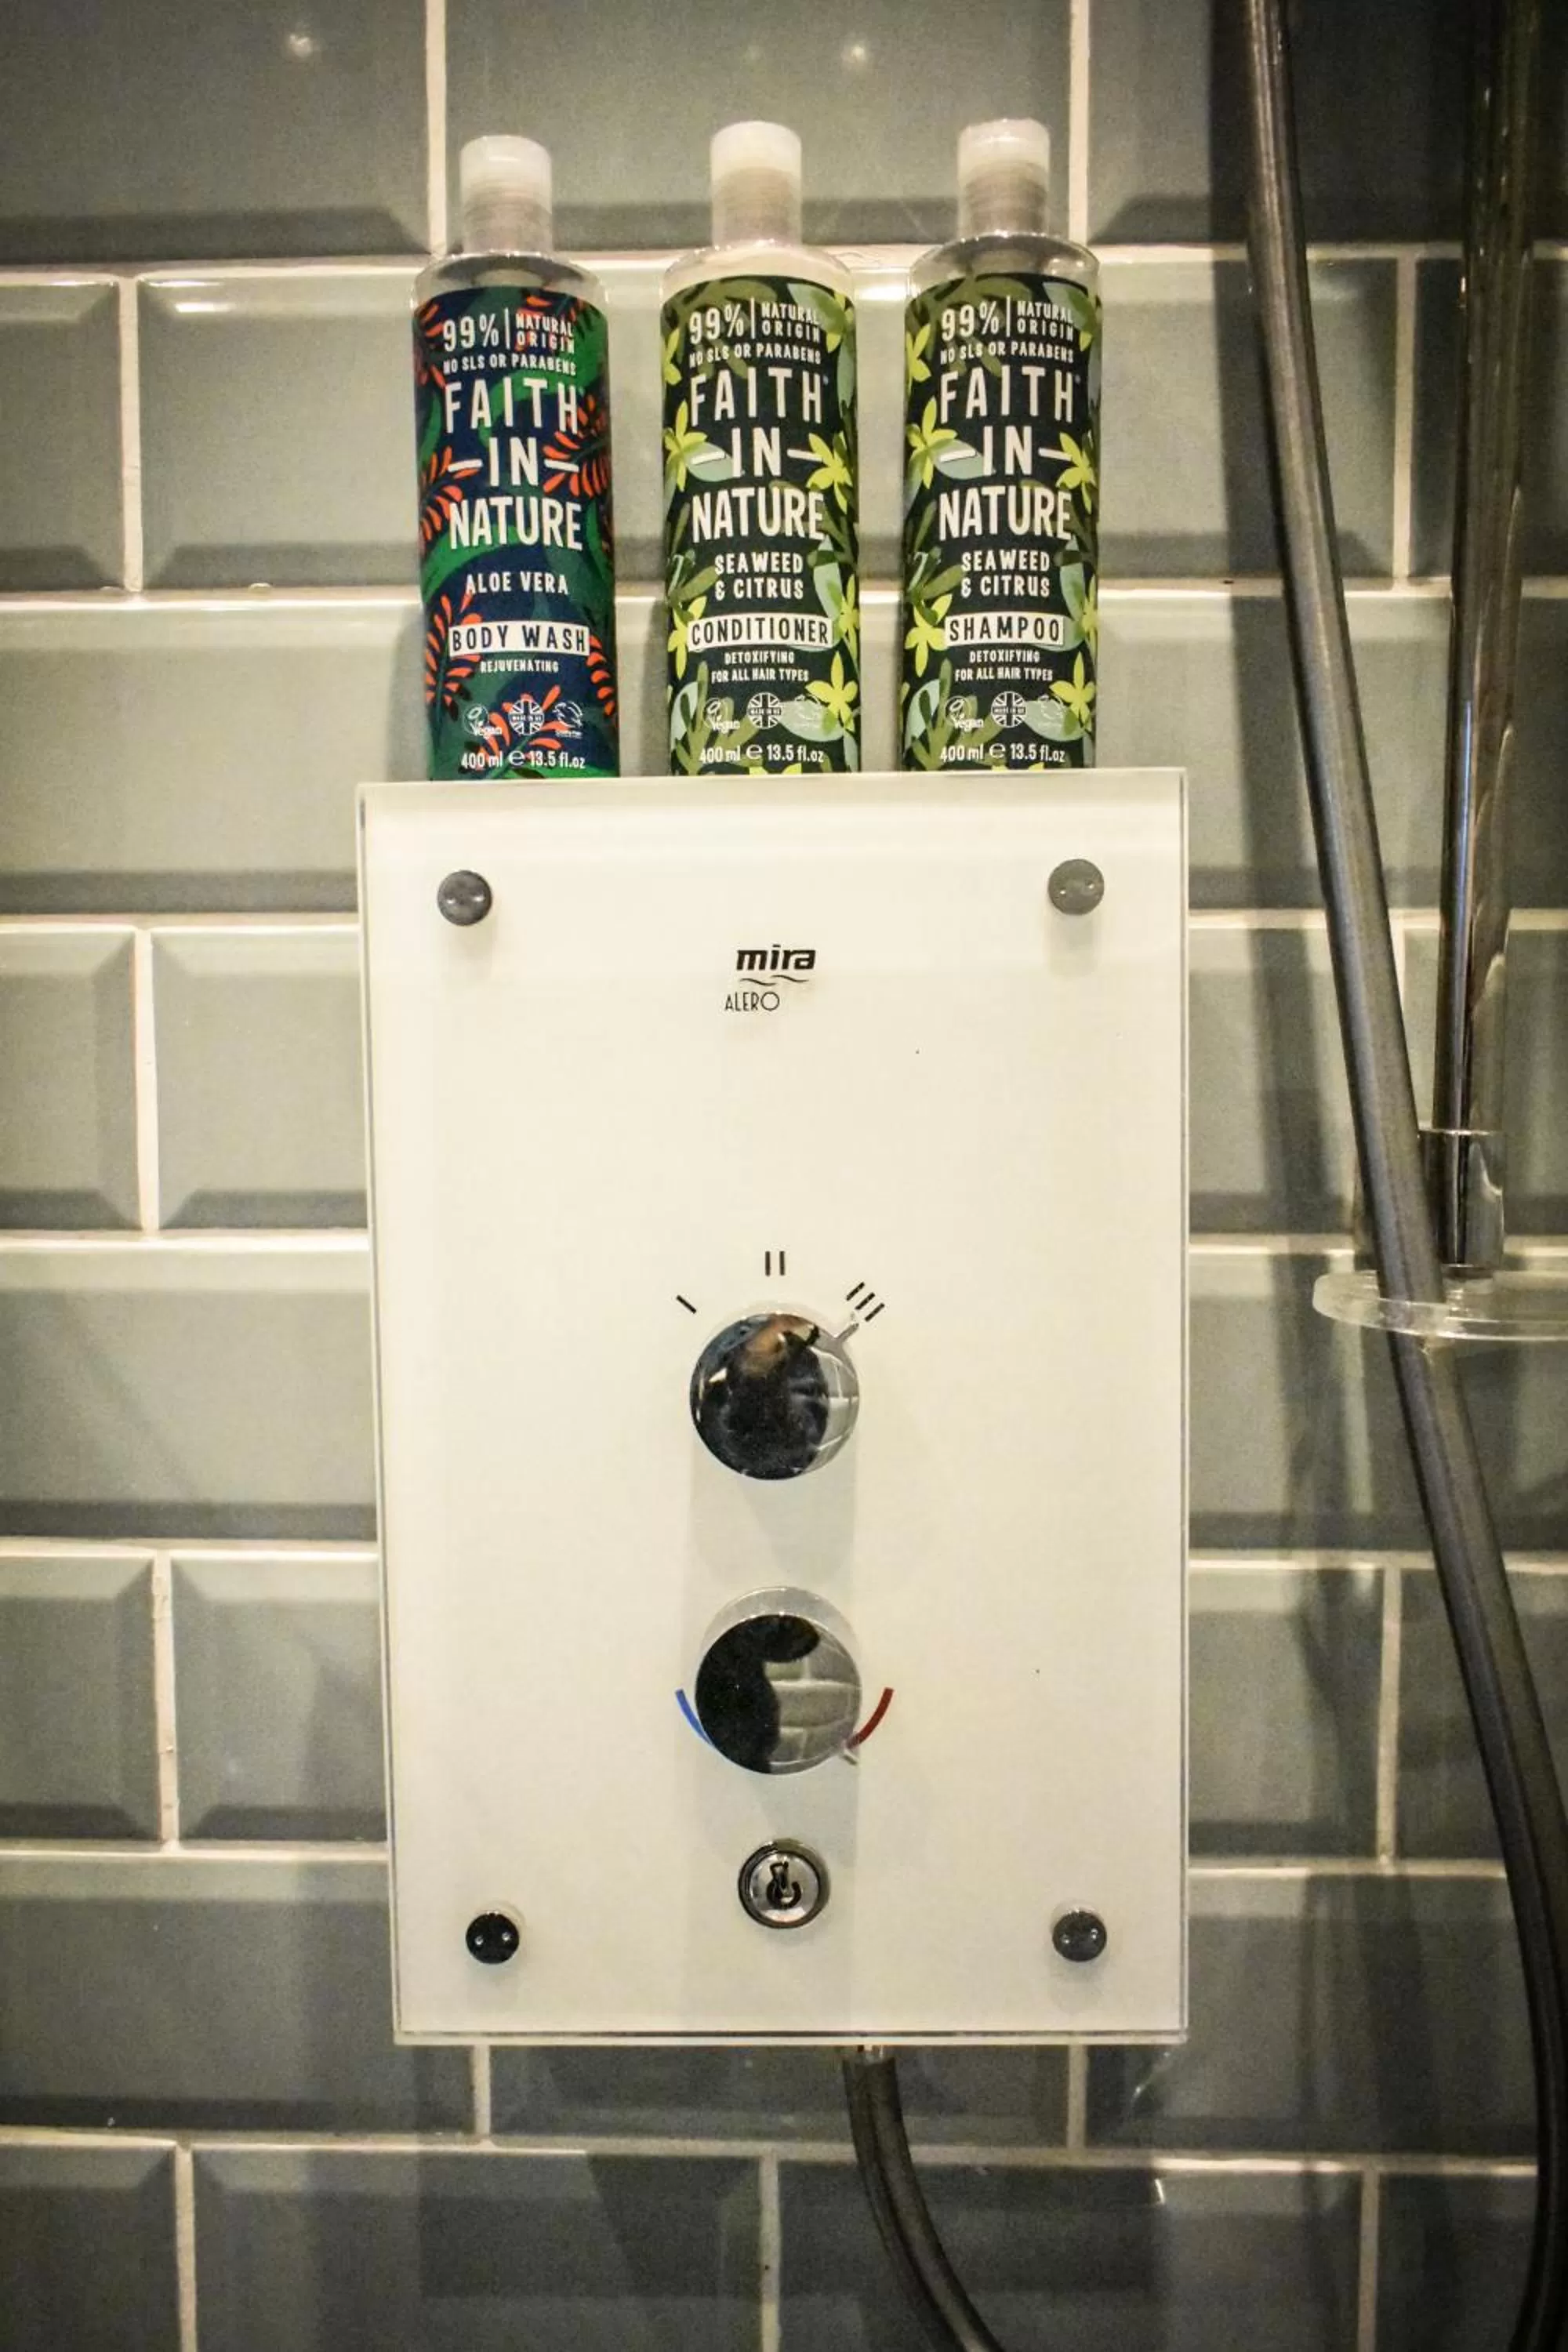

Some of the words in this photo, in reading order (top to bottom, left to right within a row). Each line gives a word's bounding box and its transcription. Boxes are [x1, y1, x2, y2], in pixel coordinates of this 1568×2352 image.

[761, 302, 819, 325] NATURAL
[942, 301, 999, 342] 99%
[1017, 300, 1073, 323] NATURAL
[443, 314, 499, 352] 99%
[516, 314, 574, 337] NATURAL
[689, 303, 744, 344] 99%
[761, 320, 821, 343] ORIGIN
[1017, 318, 1073, 341] ORIGIN
[517, 331, 575, 354] ORIGIN
[940, 347, 955, 365] NO
[960, 343, 983, 360] SLS
[988, 341, 1006, 356] OR
[1011, 341, 1074, 364] PARABENS
[443, 358, 458, 375] NO
[462, 354, 485, 371] SLS
[489, 354, 506, 368] OR
[511, 354, 576, 376] PARABENS
[689, 350, 703, 368] NO
[706, 345, 730, 363] SLS
[734, 343, 751, 358] OR
[756, 343, 821, 365] PARABENS
[445, 376, 578, 434] FAITH
[690, 367, 821, 426] FAITH
[940, 365, 1073, 424] FAITH
[488, 437, 539, 486] IN
[731, 427, 781, 478] IN
[982, 426, 1033, 476] IN
[449, 496, 583, 551] NATURE
[691, 487, 824, 543] NATURE
[938, 486, 1072, 541] NATURE
[714, 552, 804, 575] SEAWEED
[961, 550, 1050, 572] SEAWEED
[466, 572, 510, 594] ALOE
[520, 571, 568, 595] VERA
[733, 578, 804, 600] CITRUS
[980, 575, 1050, 597] CITRUS
[452, 625, 509, 652] BODY
[522, 625, 586, 653] WASH
[691, 617, 829, 646] CONDITIONER
[949, 615, 1059, 641] SHAMPOO
[481, 659, 559, 673] REJUVENATING
[724, 650, 795, 665] DETOXIFYING
[969, 649, 1040, 663] DETOXIFYING
[711, 670, 728, 684] FOR
[732, 669, 750, 681] ALL
[752, 668, 775, 681] HAIR
[779, 669, 809, 682] TYPES
[955, 669, 973, 681] FOR
[976, 667, 993, 681] ALL
[997, 667, 1021, 680] HAIR
[1025, 668, 1052, 681] TYPES
[461, 753, 485, 769] 400
[488, 751, 503, 768] ml
[529, 750, 556, 768] 13.5
[699, 746, 723, 764] 400
[725, 746, 741, 761] ml
[767, 745, 794, 760] 13.5
[940, 746, 964, 762] 400
[968, 744, 983, 760] ml
[1010, 743, 1037, 760] 13.5
[736, 944, 815, 971] mira
[724, 991, 780, 1011] ALERO
